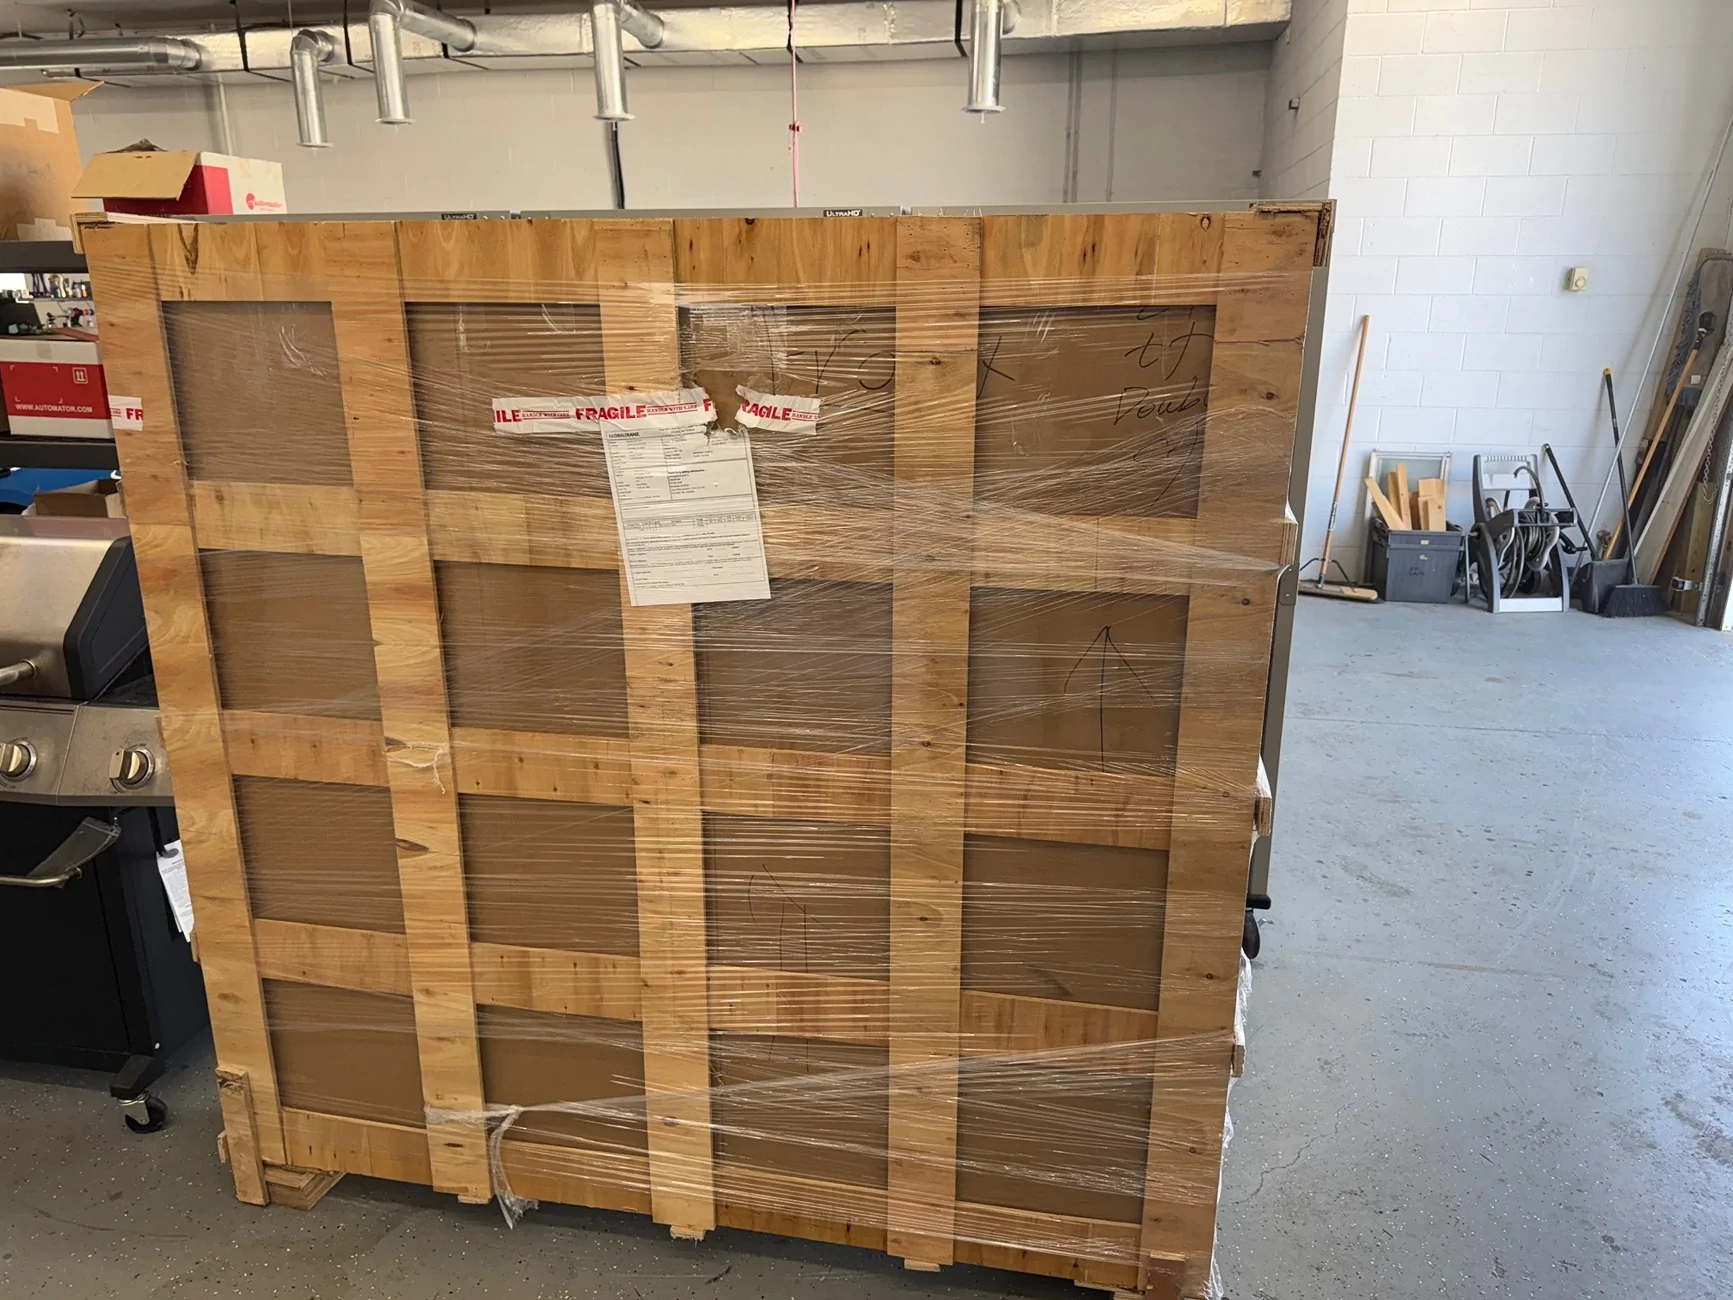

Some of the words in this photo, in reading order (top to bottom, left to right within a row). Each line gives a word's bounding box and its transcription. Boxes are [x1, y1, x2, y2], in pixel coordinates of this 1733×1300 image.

[14, 403, 93, 413] WWW.AUTOMATOR.COM
[125, 407, 143, 420] FR
[493, 409, 522, 423] ILE
[575, 404, 647, 421] FRAGILE
